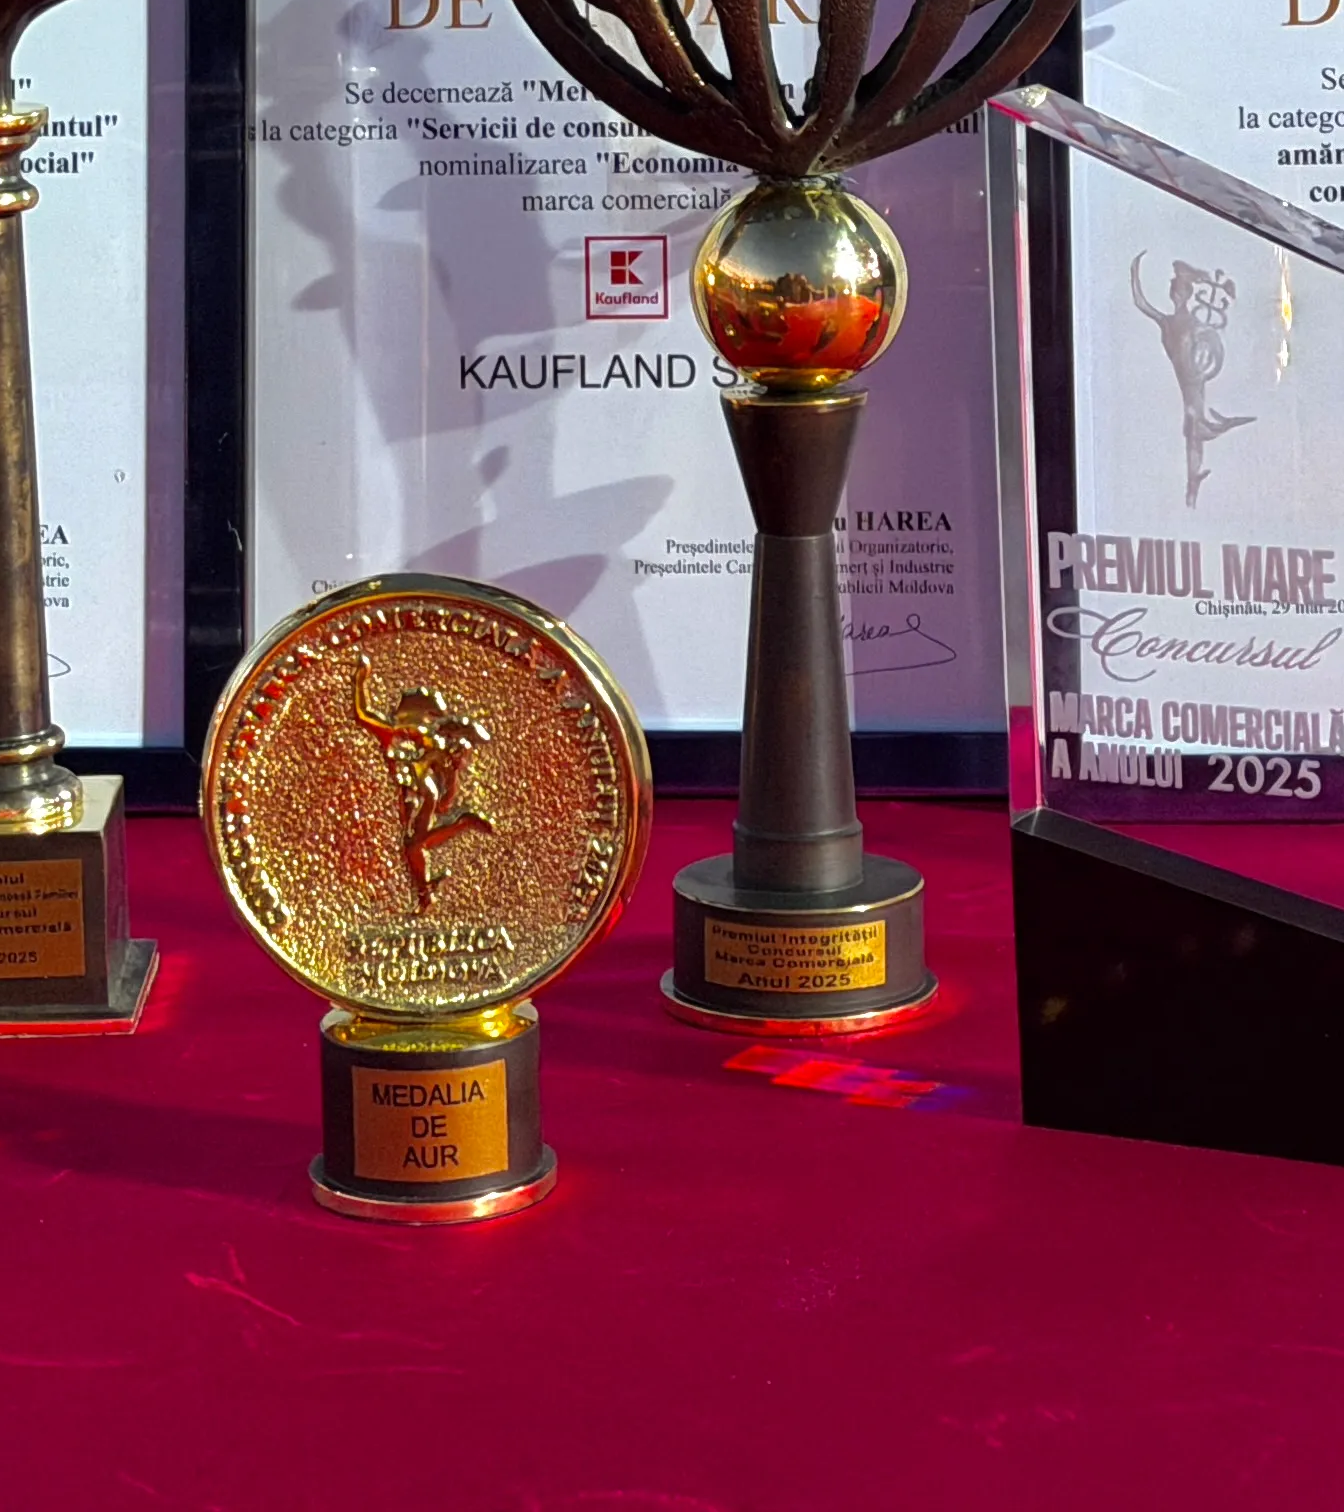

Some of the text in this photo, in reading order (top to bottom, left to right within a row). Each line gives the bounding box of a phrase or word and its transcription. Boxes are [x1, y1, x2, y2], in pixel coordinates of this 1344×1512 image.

[344, 82, 374, 105] Se
[382, 80, 514, 106] decernează
[1238, 105, 1260, 130] la
[261, 116, 556, 147] la categoria "Servicii de
[420, 154, 587, 176] nominalizarea
[522, 193, 594, 211] marca
[595, 292, 659, 306] Kaufland
[460, 353, 696, 390] KAUFLAND
[856, 510, 953, 531] HAREA
[890, 558, 955, 574] Industrie
[1047, 531, 1336, 608] PREMIUL MARE
[888, 579, 955, 595] Moldova
[1271, 600, 1291, 614] 29
[1047, 606, 1343, 683] Concursul
[1049, 691, 1153, 740] MARCA
[1051, 739, 1322, 800] A ANULUI 2025
[711, 924, 777, 946] Premiul
[714, 949, 875, 971] Marca Comercială
[747, 945, 843, 958] Concursul
[737, 971, 852, 990] Anul 2025
[371, 1079, 486, 1108] MEDALIA
[411, 1115, 448, 1139] DE
[402, 1144, 460, 1170] AUR
